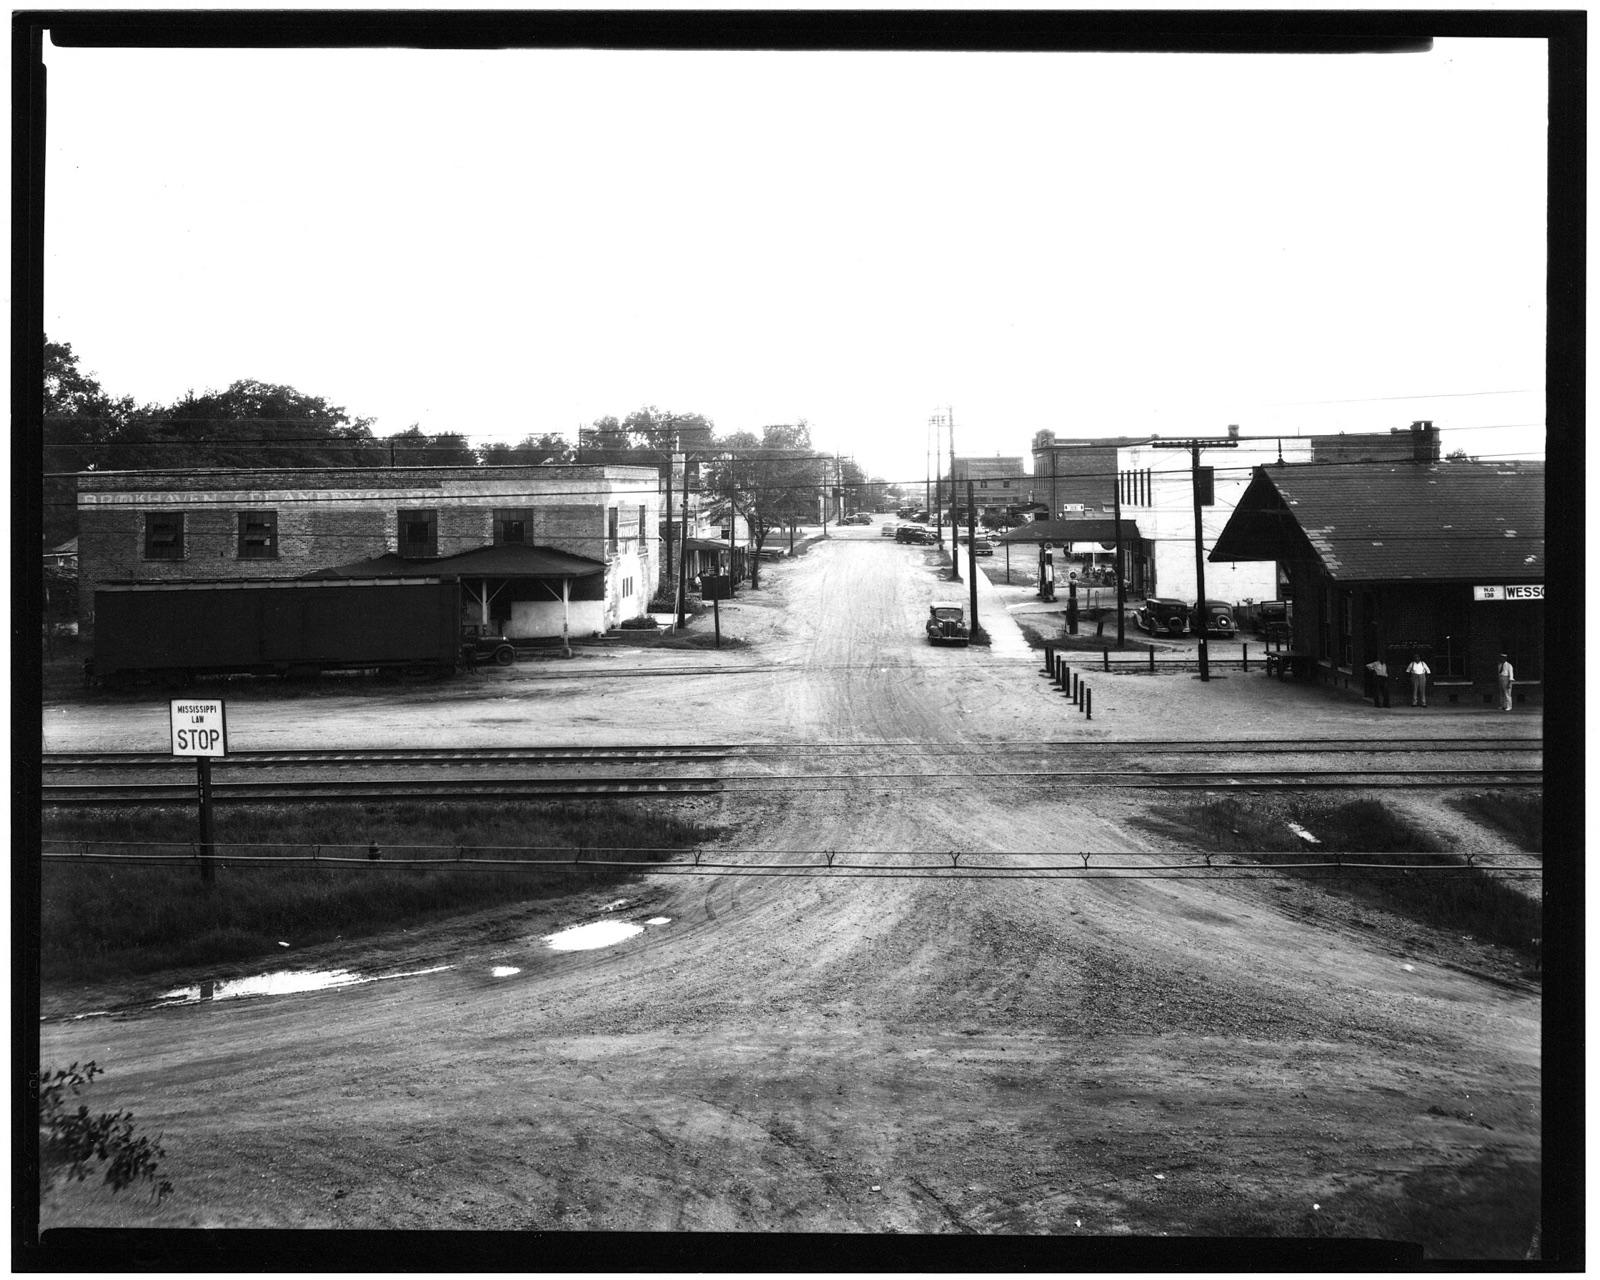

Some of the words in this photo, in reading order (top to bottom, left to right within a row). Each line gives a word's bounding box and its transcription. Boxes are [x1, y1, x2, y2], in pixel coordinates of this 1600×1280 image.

[177, 705, 217, 714] MISSISSIPPI
[191, 715, 204, 724] LAW
[177, 729, 220, 751] STOP
